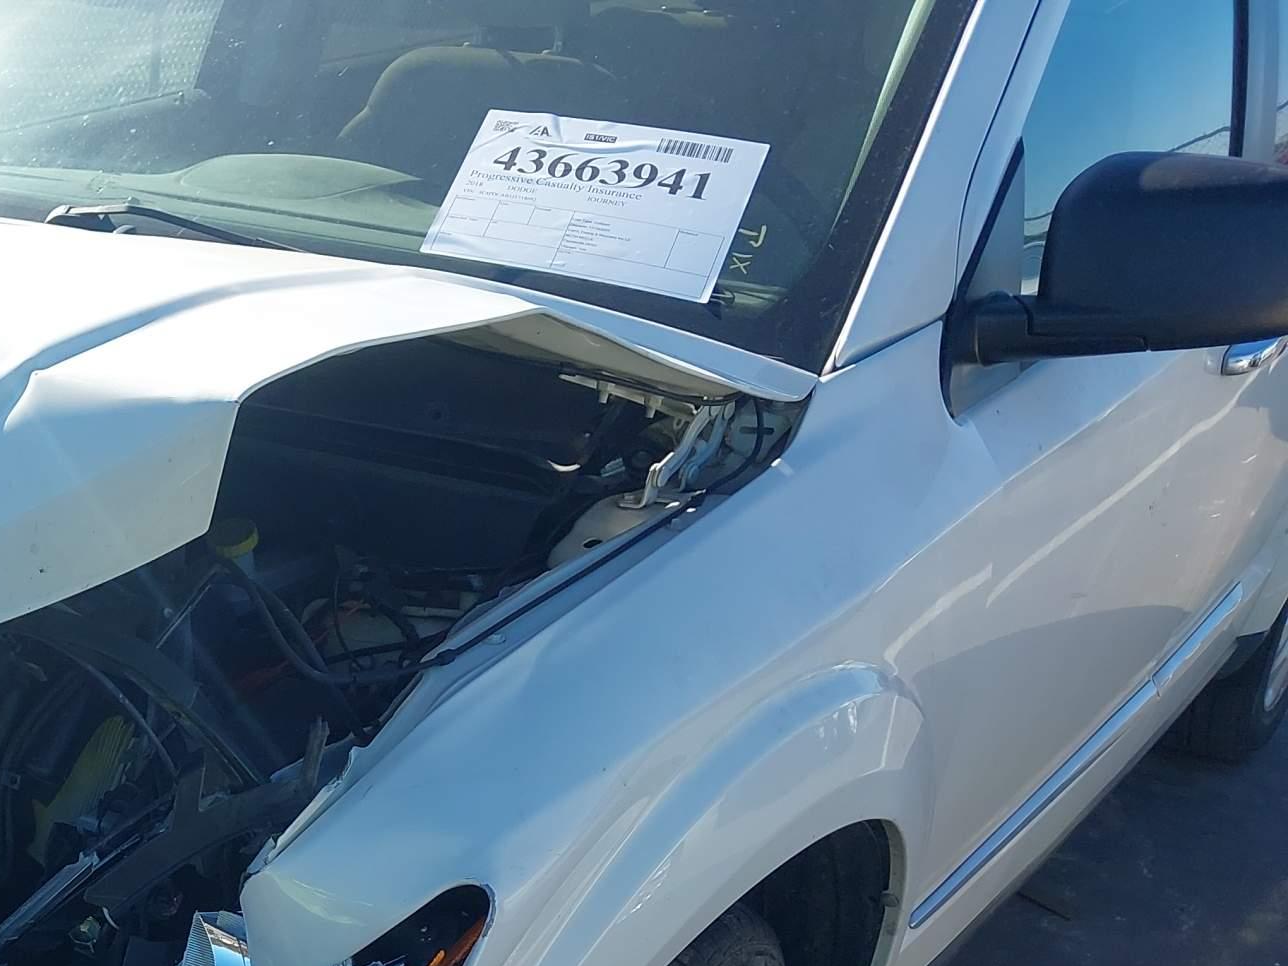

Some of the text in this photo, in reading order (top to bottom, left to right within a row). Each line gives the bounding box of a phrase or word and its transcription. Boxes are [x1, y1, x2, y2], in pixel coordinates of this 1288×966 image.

[470, 169, 643, 201] Progressive Casualty Insurance
[493, 146, 712, 201] 43663941
[587, 195, 626, 208] JOURNEY
